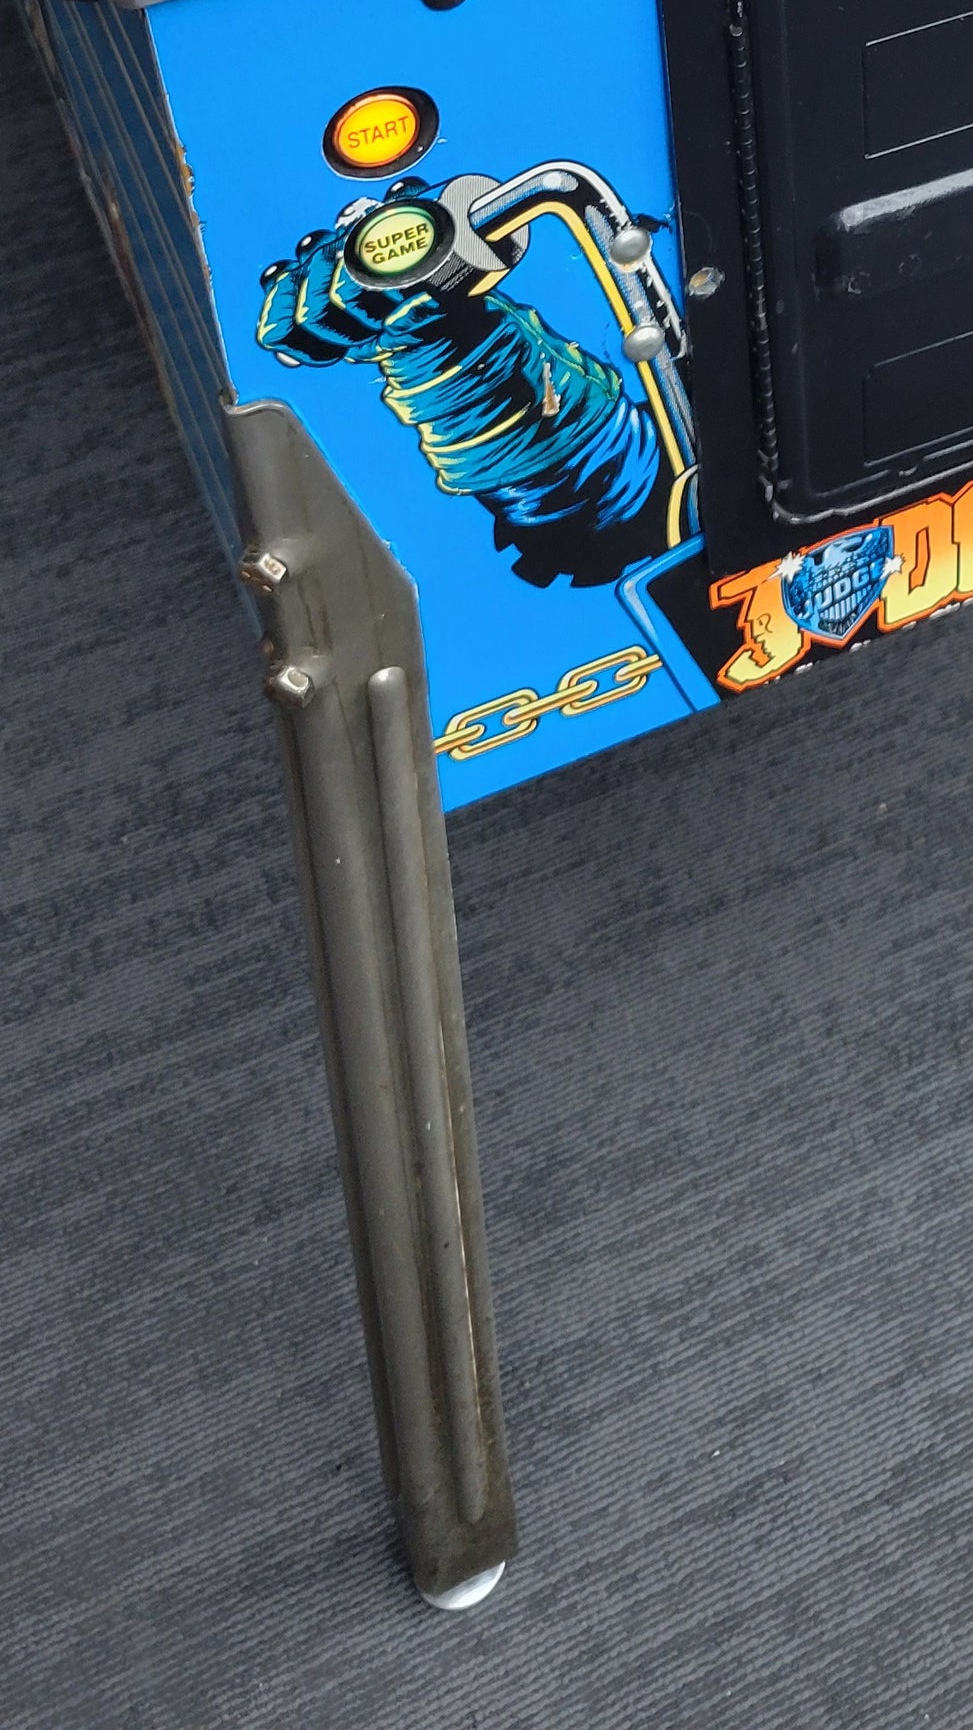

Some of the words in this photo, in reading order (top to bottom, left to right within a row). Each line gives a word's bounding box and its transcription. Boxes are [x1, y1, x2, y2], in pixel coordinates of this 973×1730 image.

[347, 115, 410, 149] START
[364, 222, 430, 255] SUPER
[372, 236, 429, 266] GAME
